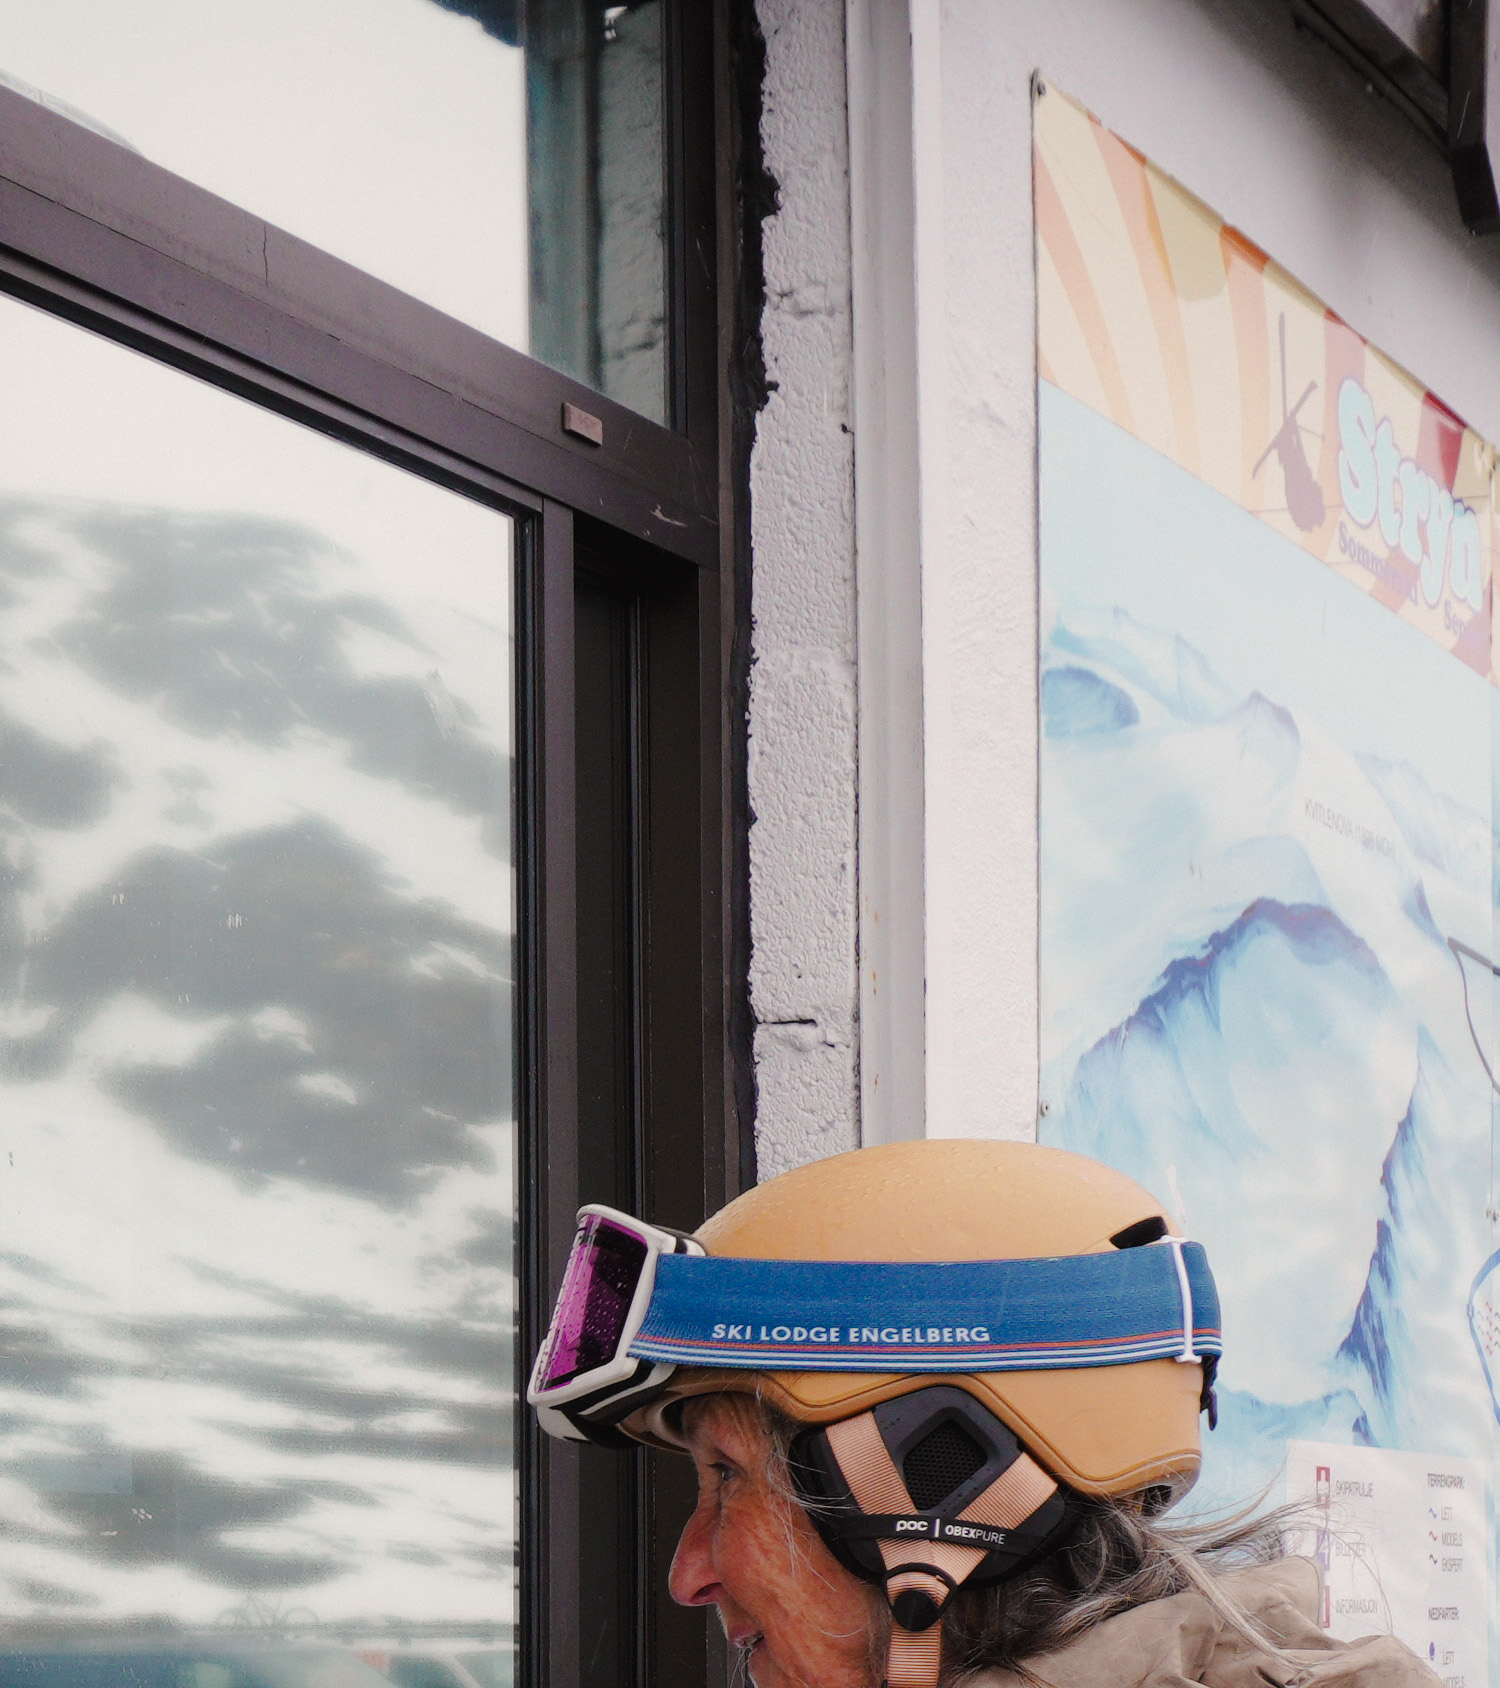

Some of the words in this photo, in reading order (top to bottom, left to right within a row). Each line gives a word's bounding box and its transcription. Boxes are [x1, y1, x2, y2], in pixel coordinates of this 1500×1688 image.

[1338, 375, 1483, 612] Stryn
[711, 1323, 754, 1341] SKI
[760, 1324, 842, 1343] LODGE
[848, 1324, 992, 1344] ENGELBERG
